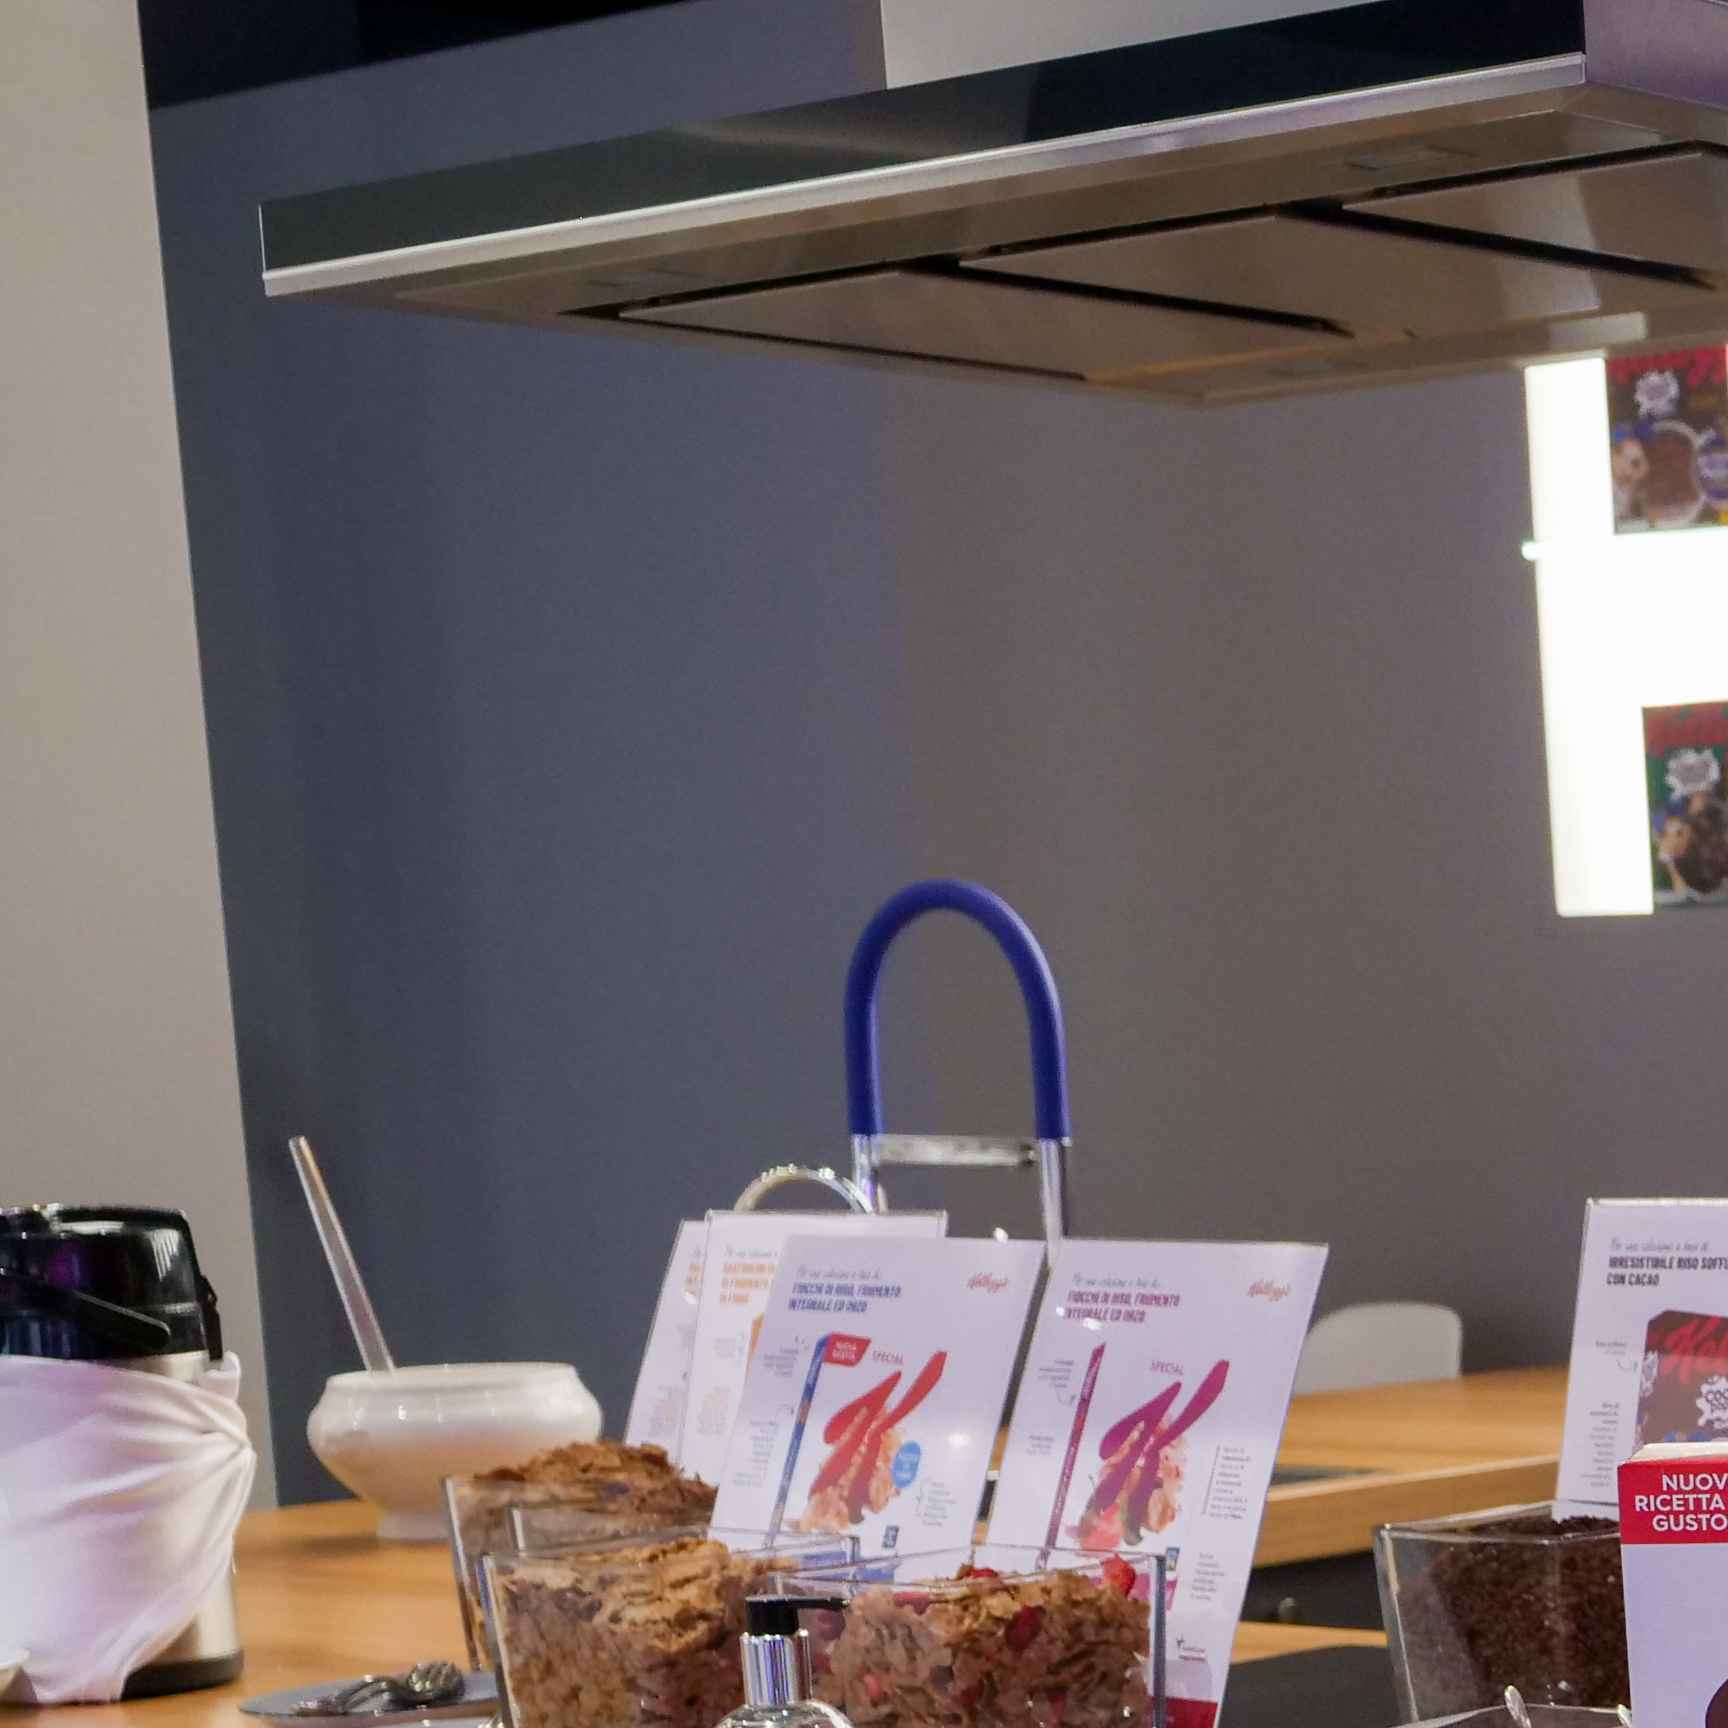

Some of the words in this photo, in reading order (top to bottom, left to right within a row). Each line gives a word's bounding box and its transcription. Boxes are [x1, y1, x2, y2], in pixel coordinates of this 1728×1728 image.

[1608, 1255, 1674, 1270] IRRESISTIBILE
[1676, 1256, 1699, 1270] RISO
[1606, 1272, 1626, 1286] CON
[1627, 1273, 1660, 1287] CACAO
[1634, 1492, 1728, 1512] RICETTA
